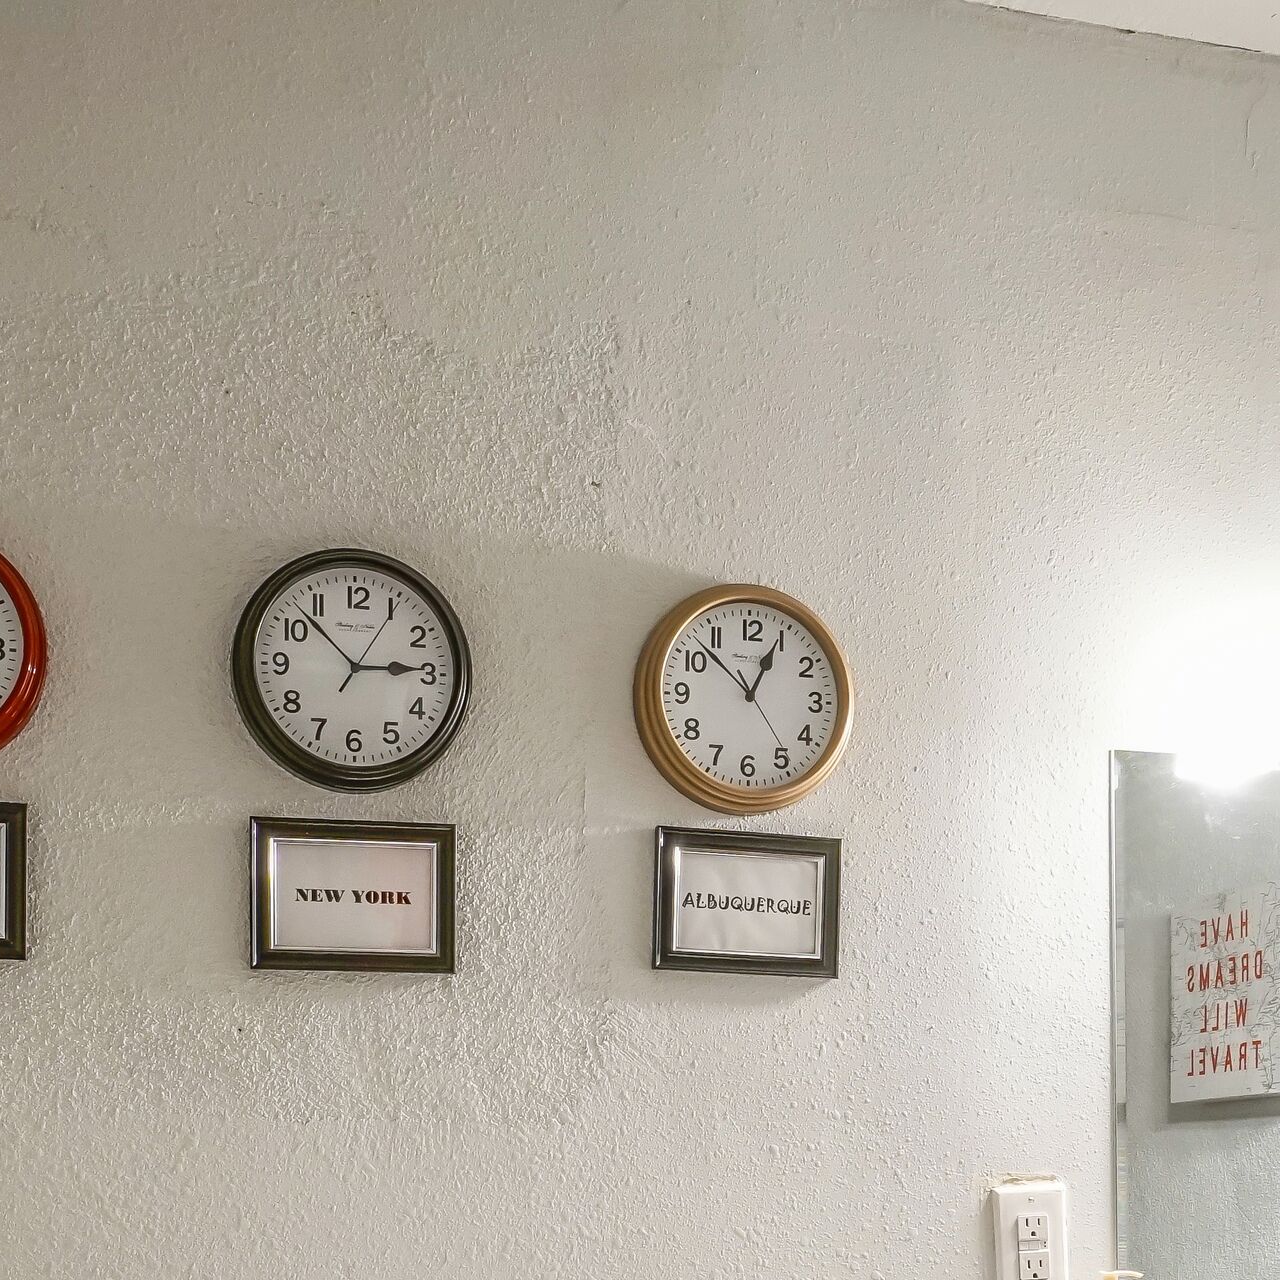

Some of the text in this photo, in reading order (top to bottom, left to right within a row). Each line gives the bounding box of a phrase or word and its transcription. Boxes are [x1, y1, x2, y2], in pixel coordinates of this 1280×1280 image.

[312, 593, 324, 617] 11
[347, 586, 370, 610] 12
[388, 597, 393, 620] 1
[284, 618, 308, 643] 10
[410, 625, 426, 648] 2
[711, 626, 721, 648] 11
[742, 619, 763, 642] 12
[779, 630, 784, 652] 1
[272, 651, 290, 675] 9
[685, 650, 707, 673] 10
[799, 657, 814, 678] 2
[420, 662, 437, 685] 3
[282, 690, 301, 713] 8
[674, 682, 690, 704] 9
[808, 692, 823, 713] 3
[409, 697, 425, 719] 4
[310, 718, 328, 740] 7
[382, 721, 400, 744] 5
[684, 718, 700, 740] 8
[797, 725, 813, 746] 4
[345, 729, 362, 752] 6
[709, 744, 724, 766] 7
[740, 755, 755, 777] 6
[773, 748, 789, 769] 5
[294, 888, 412, 905] NEW YORK
[681, 892, 812, 916] ALBUQUERQUE
